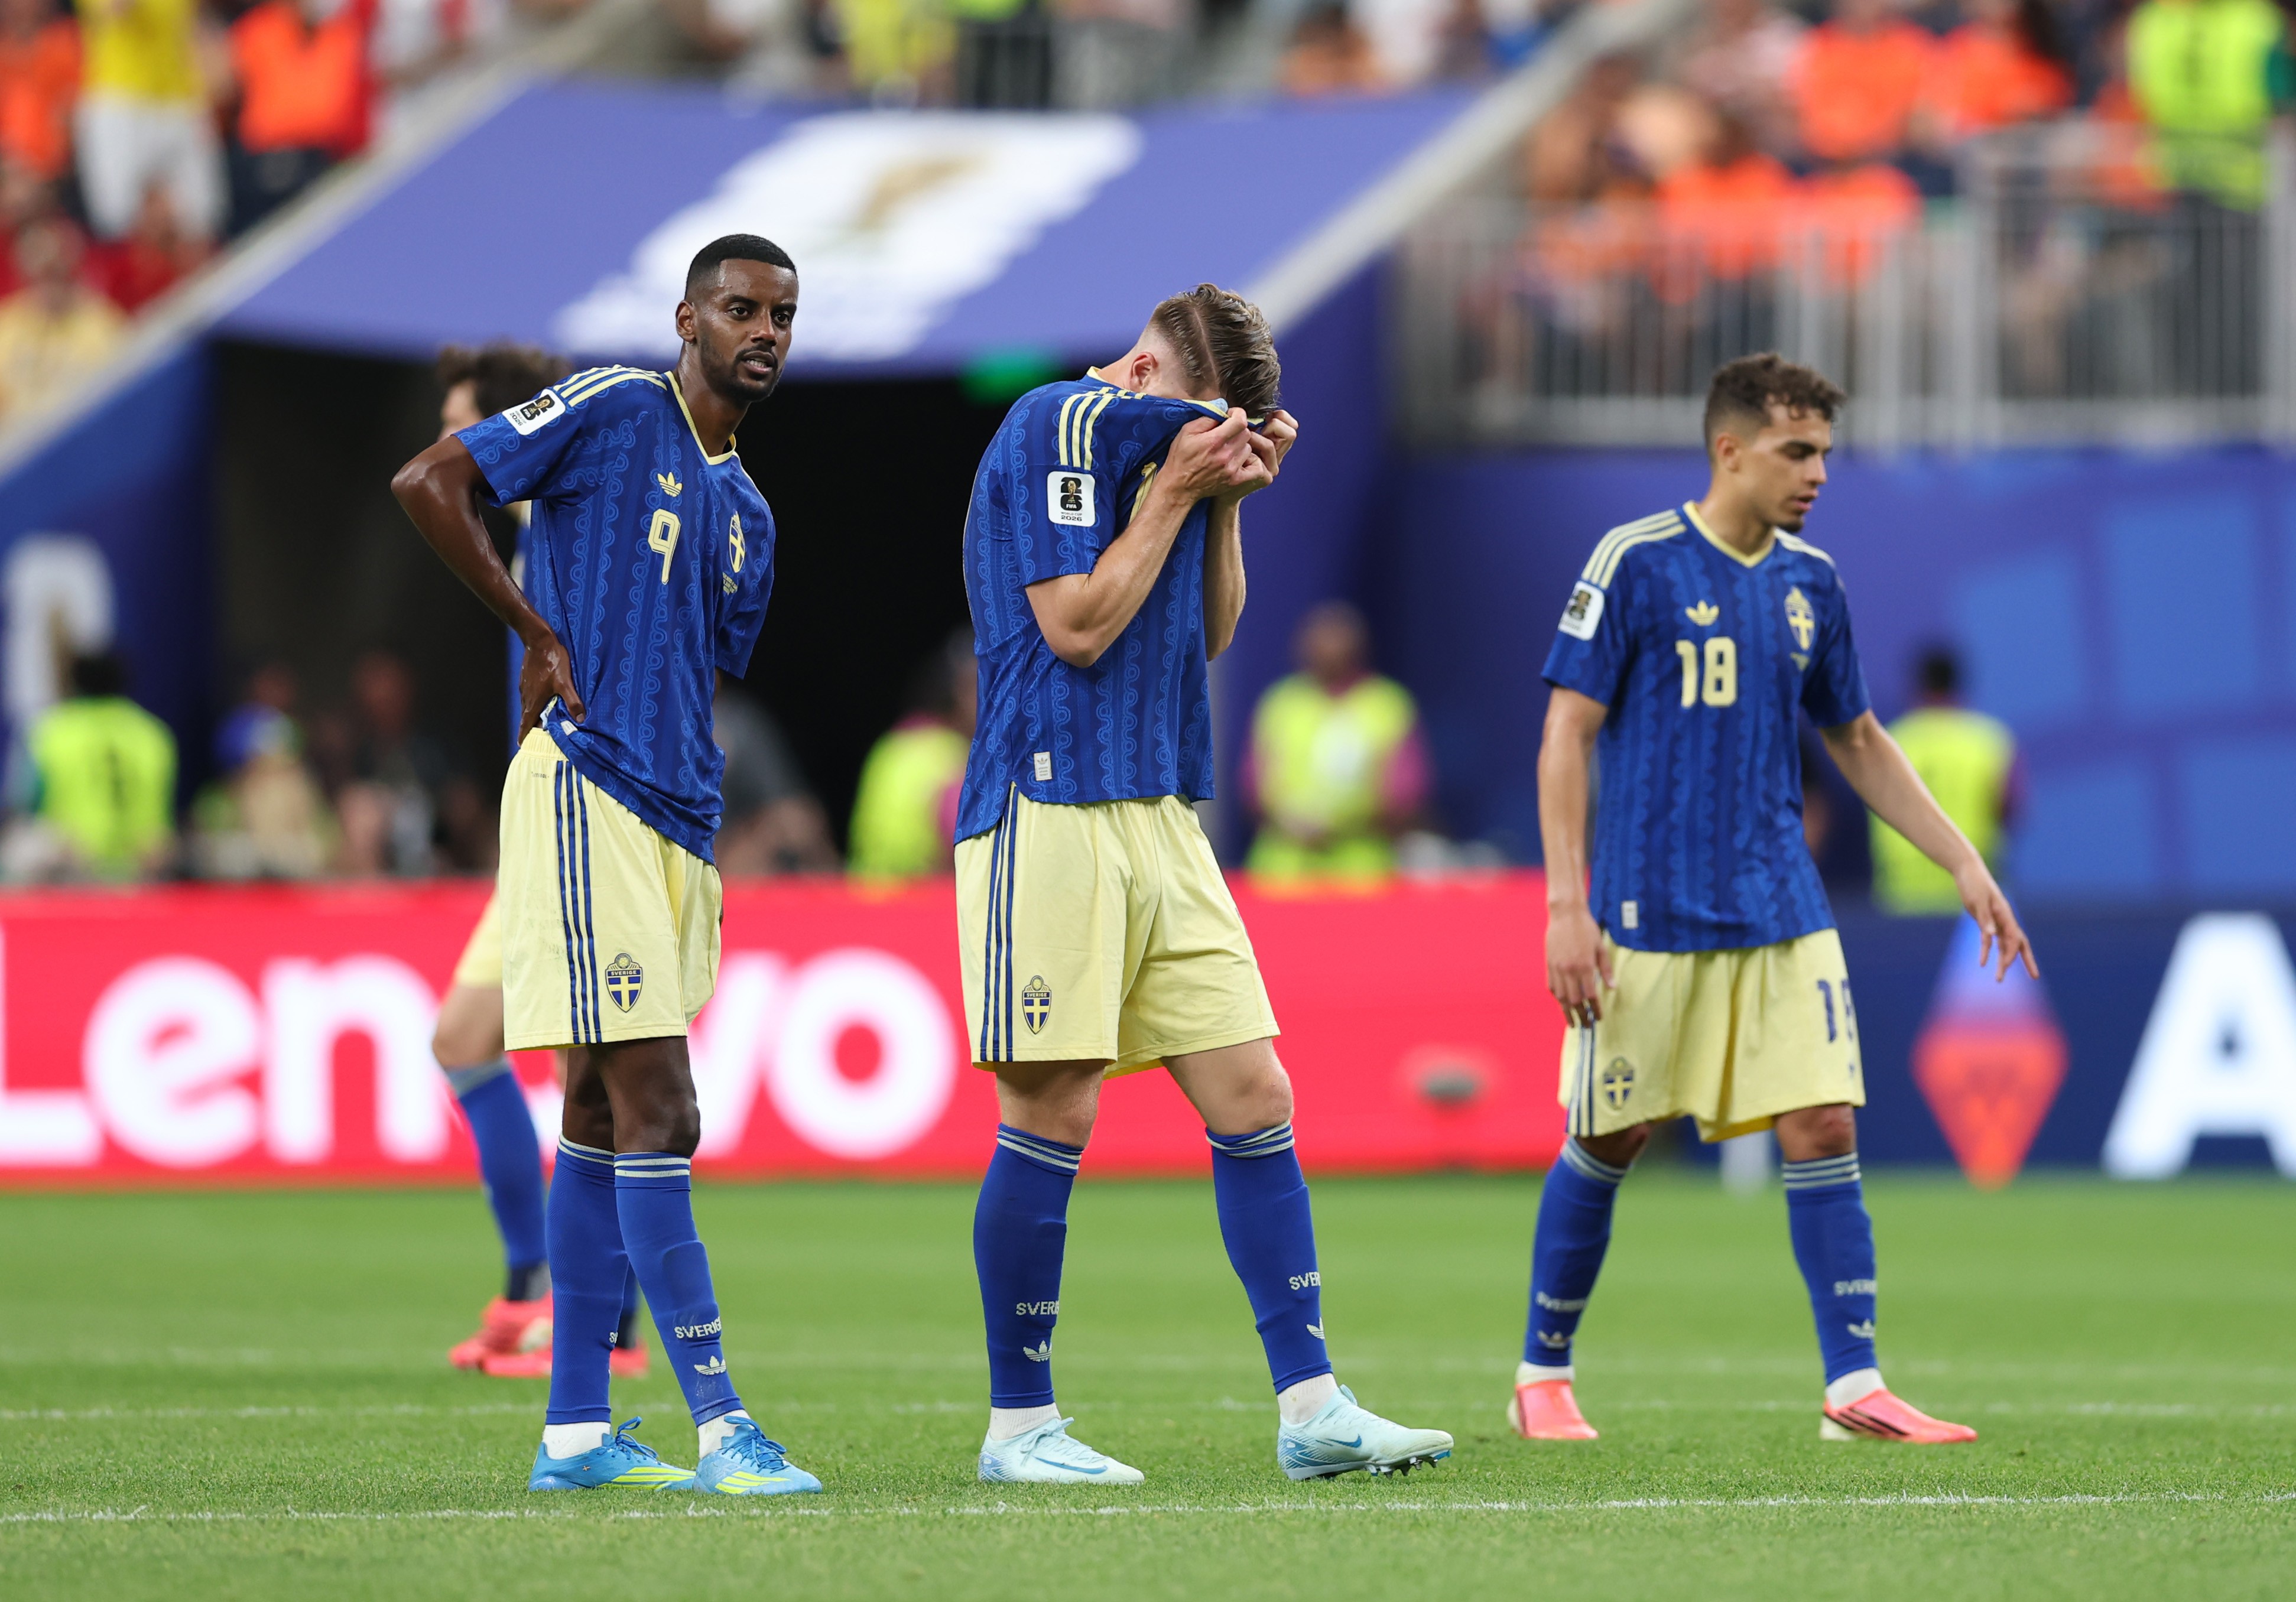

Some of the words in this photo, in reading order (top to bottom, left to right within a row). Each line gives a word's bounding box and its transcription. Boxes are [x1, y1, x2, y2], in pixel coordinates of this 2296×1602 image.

[509, 412, 523, 426] 2026
[648, 508, 681, 586] 9
[1675, 636, 1738, 709] 18
